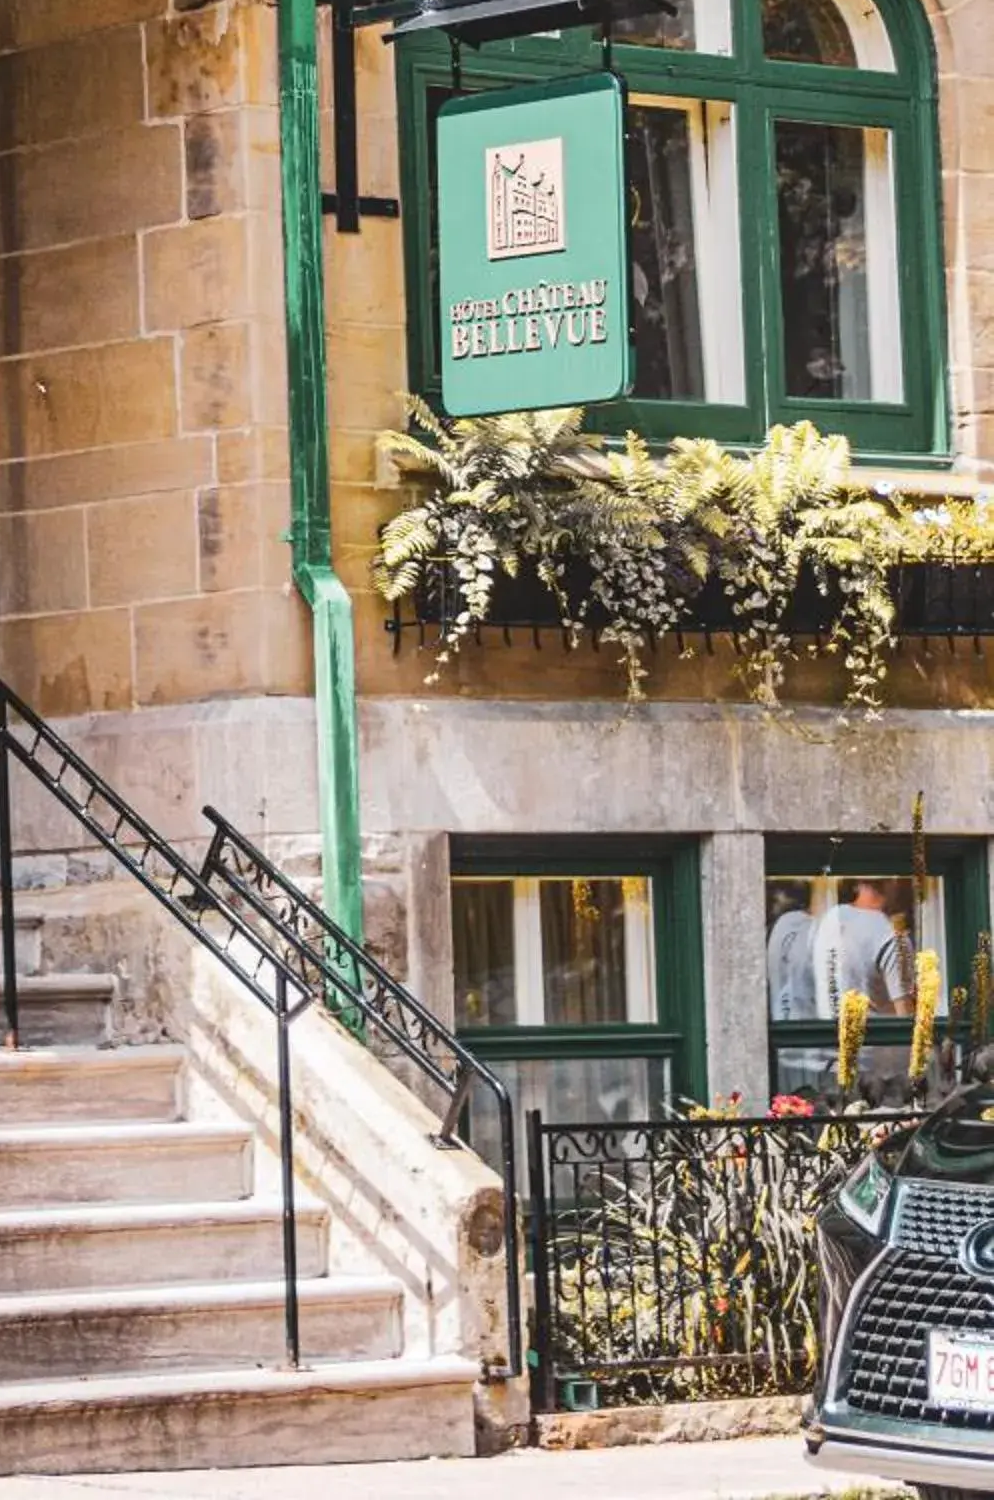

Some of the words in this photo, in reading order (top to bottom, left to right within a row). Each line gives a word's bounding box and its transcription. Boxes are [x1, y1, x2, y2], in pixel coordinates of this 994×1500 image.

[451, 297, 501, 324] HÔTEL
[502, 279, 607, 317] CHÂTEAU
[452, 309, 607, 360] BELLEVUE
